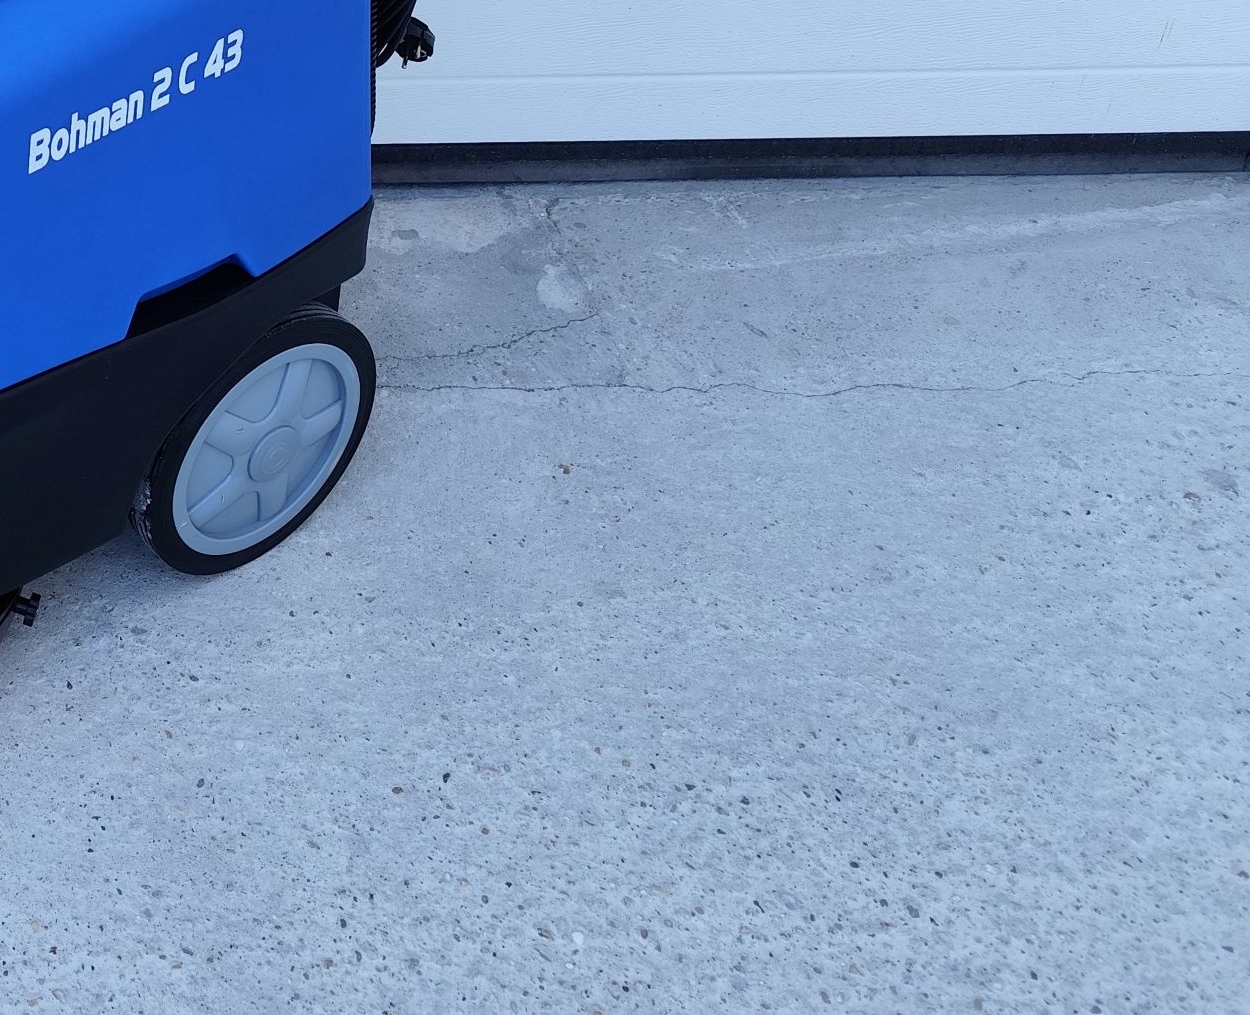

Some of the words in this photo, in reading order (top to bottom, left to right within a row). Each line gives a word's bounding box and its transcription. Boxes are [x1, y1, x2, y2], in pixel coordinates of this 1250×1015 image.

[28, 90, 144, 174] Bohman
[151, 67, 172, 112] 2
[179, 51, 198, 95] C
[204, 29, 244, 78] 43
